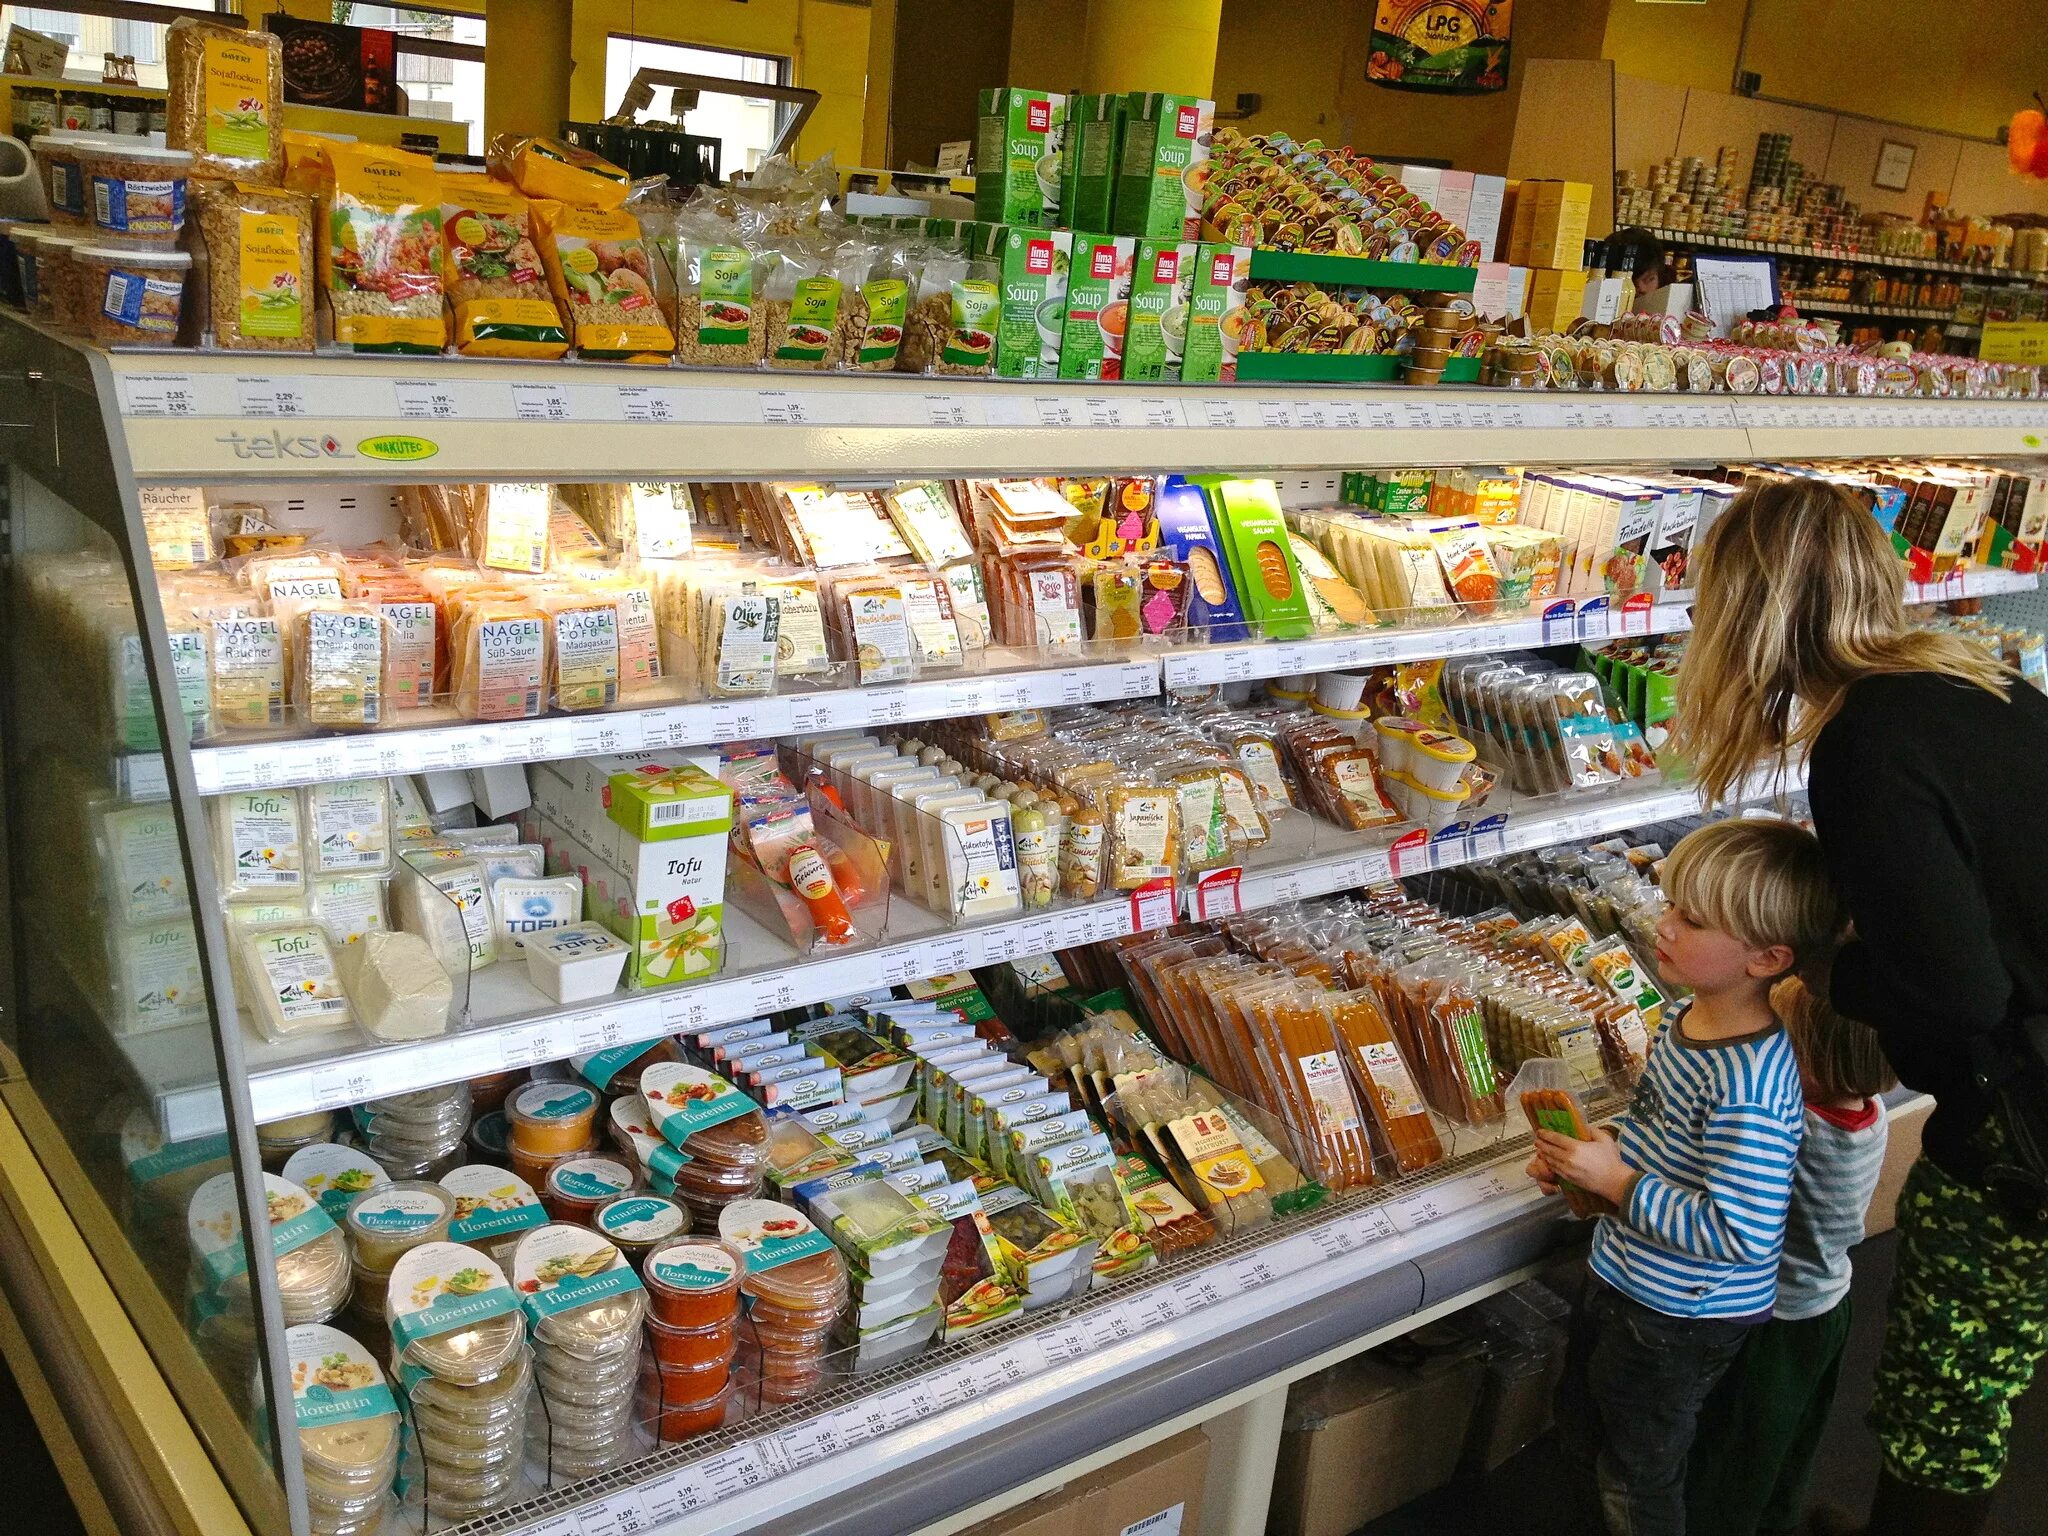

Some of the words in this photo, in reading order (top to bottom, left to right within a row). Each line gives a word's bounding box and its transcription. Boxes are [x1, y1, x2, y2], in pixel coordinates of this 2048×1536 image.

[1426, 14, 1461, 33] LPG
[210, 66, 262, 86] Sojaflocken
[1030, 106, 1047, 120] lima
[1180, 110, 1195, 124] lima
[1010, 139, 1039, 158] Soup
[1158, 146, 1185, 165] Soup
[126, 180, 174, 194] Röstzwiebeln
[127, 219, 173, 233] KNUSPRIG
[245, 243, 296, 258] Sojaflocken
[1030, 246, 1050, 260] lima
[1095, 251, 1113, 265] lima
[1157, 257, 1175, 270] lima
[1214, 260, 1231, 272] lima
[714, 268, 739, 283] Soja
[880, 295, 900, 307] Soja
[1006, 284, 1038, 305] Soup
[1071, 287, 1102, 307] Soup
[804, 295, 827, 309] Soja
[965, 299, 989, 313] Soja
[1135, 292, 1164, 311] Soup
[1195, 295, 1221, 313] Soup
[166, 391, 185, 399] 2,35
[275, 392, 293, 400] 2,29
[168, 403, 187, 411] 2,95
[433, 406, 449, 414] 2,59
[373, 441, 423, 454] WAKUTEC
[143, 493, 192, 505] Räucher
[273, 582, 337, 598] NAGEL
[1038, 580, 1062, 593] Rosso
[1064, 574, 1078, 606] TOFU
[732, 606, 764, 621] Olive
[763, 597, 780, 643] TOFU
[315, 615, 377, 630] NAGEL
[559, 612, 614, 630] NAGEL
[217, 620, 278, 636] NAGEL
[482, 623, 540, 637] NAGEL
[315, 639, 376, 651] Champignon
[483, 636, 522, 648] TOFU
[565, 637, 612, 650] Madagaskar
[225, 646, 272, 659] Räucher
[487, 645, 536, 659] Süß-Sauer
[480, 703, 496, 711] 200g
[600, 729, 613, 738] 2,69
[668, 723, 682, 731] 2,65
[670, 733, 682, 741] 3,29
[451, 743, 466, 751] 2,59
[315, 756, 332, 765] 2,65
[380, 750, 396, 759] 2,65
[253, 763, 271, 771] 2,65
[248, 796, 280, 815] Tofu
[1129, 813, 1165, 827] Japanische
[994, 822, 1013, 872] TOFU
[1394, 836, 1424, 851] Aktionspreis
[667, 856, 702, 876] Tofu
[681, 876, 702, 886] Natur
[1202, 877, 1237, 889] Aktionspreis
[1135, 888, 1172, 900] Aktionspreis
[506, 918, 567, 934] TOFU
[271, 936, 310, 954] Tofu
[549, 935, 609, 952] TOFU
[777, 986, 789, 994] 1,95
[778, 996, 790, 1004] 2,45
[689, 1005, 700, 1013] 1,79
[690, 1015, 702, 1023] 2,25
[602, 1023, 616, 1032] 1,49
[348, 1075, 363, 1086] 1,69
[775, 1092, 811, 1107] Getrocknete
[811, 1087, 837, 1099] Tomaten
[541, 1095, 588, 1118] florentin
[681, 1099, 738, 1125] florentin
[860, 1135, 888, 1148] Tomaten
[888, 1156, 915, 1168] Tomaten
[1055, 1150, 1108, 1173] Artischockenherzen
[559, 1173, 607, 1196] florentin
[827, 1174, 865, 1190] Sheepy
[1125, 1171, 1150, 1185] JUMBOS
[915, 1179, 943, 1192] Tomaten
[945, 1198, 975, 1212] Tomaten
[366, 1215, 426, 1227] florentin
[458, 1211, 530, 1236] florentin
[753, 1236, 817, 1263] florentin
[660, 1266, 717, 1284] florentin
[545, 1277, 621, 1306] florentin
[419, 1297, 498, 1329] florentin
[1065, 1336, 1078, 1345] 3,25
[1069, 1346, 1082, 1355] 3,69
[1001, 1359, 1014, 1369] 2,59
[1006, 1368, 1020, 1379] 3,25
[958, 1377, 972, 1388] 2,59
[963, 1387, 977, 1398] 3,29
[912, 1395, 924, 1405] 3,19
[916, 1405, 930, 1416] 3,99
[865, 1413, 881, 1424] 3,25
[870, 1423, 885, 1434] 4,09
[815, 1431, 831, 1443] 2,69
[821, 1442, 836, 1453] 3,39
[737, 1463, 754, 1475] 2,65
[742, 1474, 759, 1486] 3,29
[677, 1485, 692, 1498] 3,19
[681, 1497, 697, 1510] 3,99
[616, 1508, 633, 1521] 2,59
[622, 1520, 639, 1533] 3,25
